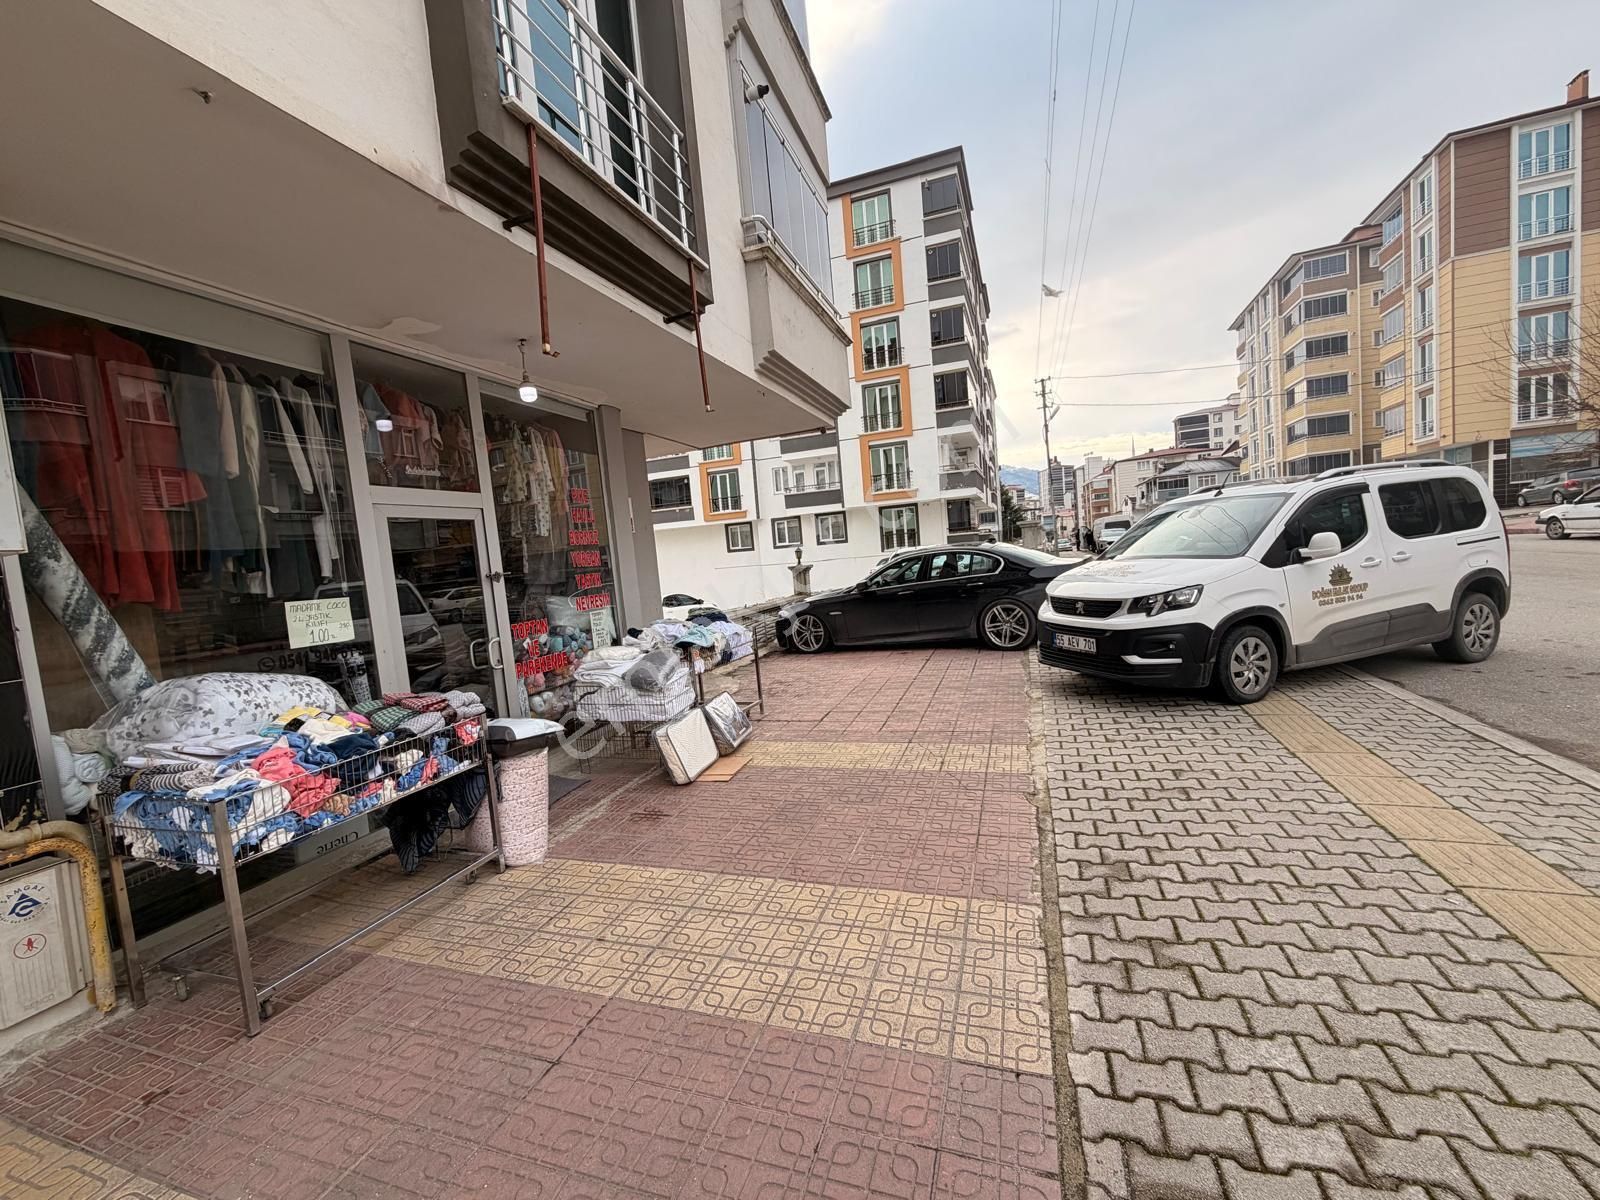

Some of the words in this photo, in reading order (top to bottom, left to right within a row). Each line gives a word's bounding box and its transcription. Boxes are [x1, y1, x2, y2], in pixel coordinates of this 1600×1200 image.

[569, 529, 599, 545] BORNOZ
[570, 551, 601, 567] YORGAN
[575, 573, 602, 589] YASTIK
[290, 603, 321, 613] MADAME
[326, 601, 348, 610] COCO
[511, 618, 548, 641] TOPTAN
[1056, 634, 1064, 646] 55
[1067, 637, 1079, 648] AEV
[1082, 639, 1095, 650] 701
[515, 651, 569, 679] PAREKENDE
